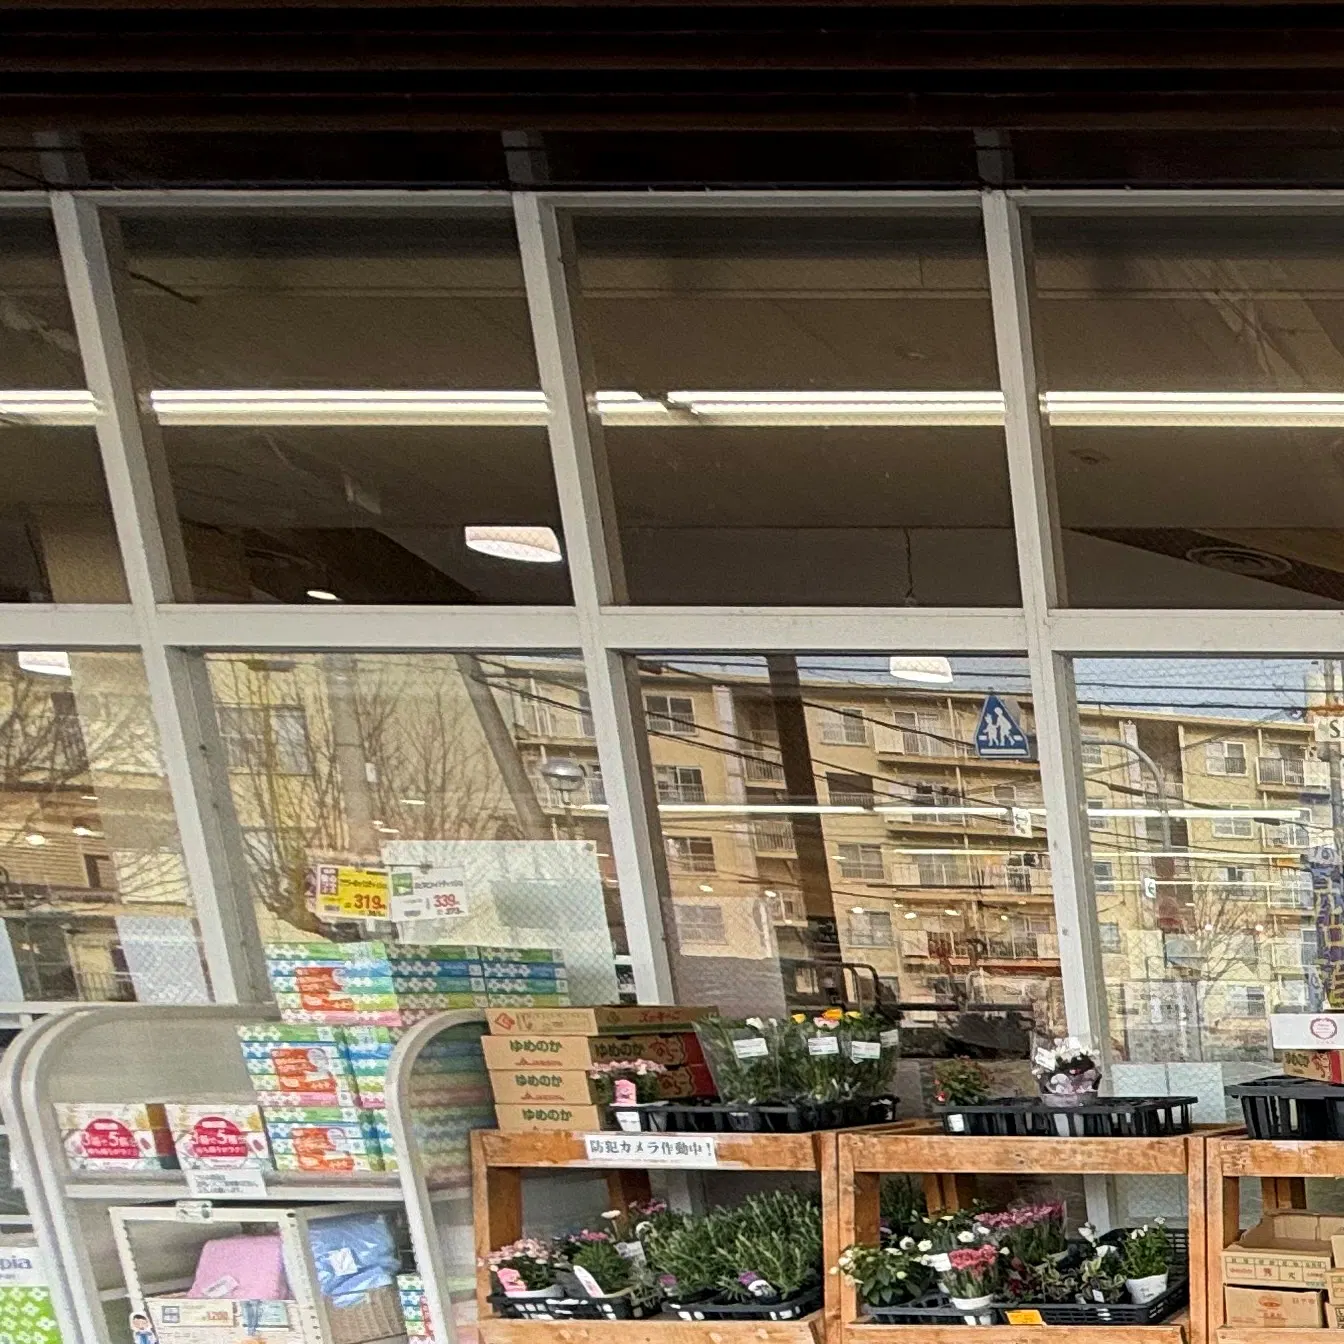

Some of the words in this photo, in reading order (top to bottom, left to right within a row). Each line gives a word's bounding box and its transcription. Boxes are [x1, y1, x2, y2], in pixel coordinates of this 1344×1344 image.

[509, 1039, 563, 1053] ゆめのか
[596, 1041, 643, 1057] ゆめのか
[515, 1073, 564, 1088] ゆめのか
[522, 1107, 572, 1122] ゆめのか
